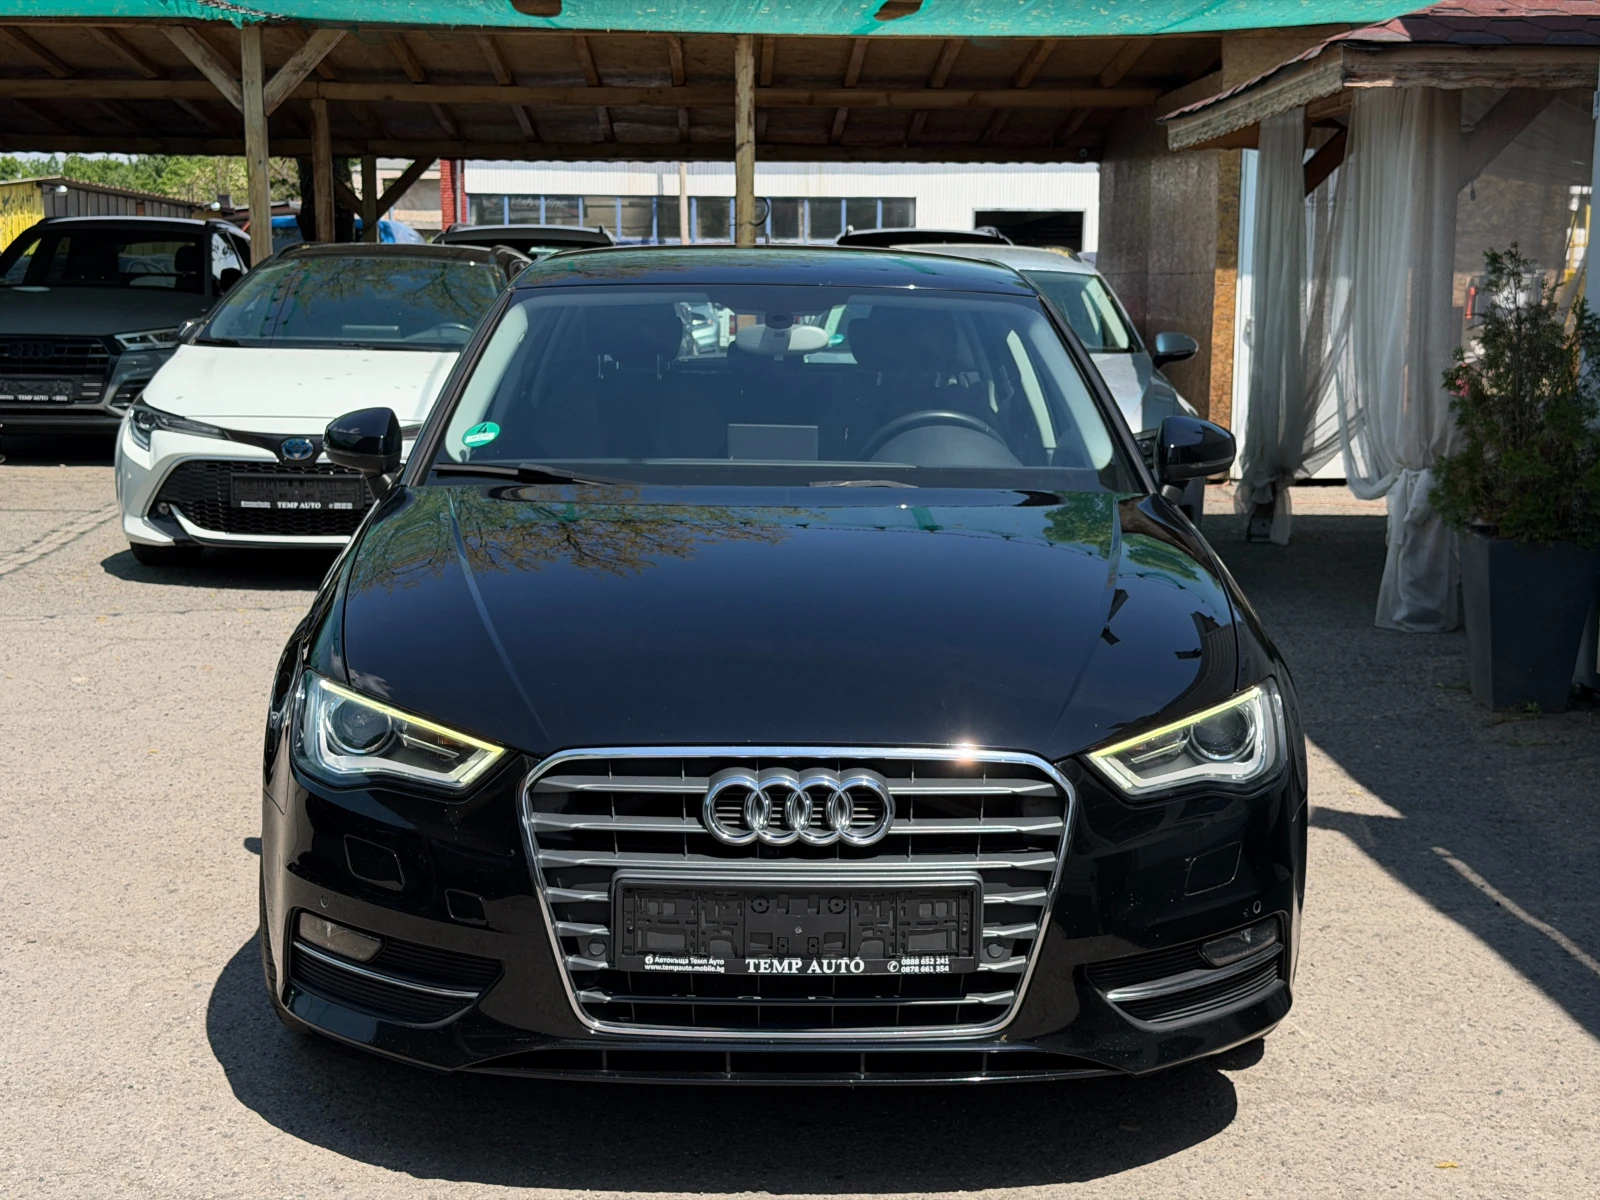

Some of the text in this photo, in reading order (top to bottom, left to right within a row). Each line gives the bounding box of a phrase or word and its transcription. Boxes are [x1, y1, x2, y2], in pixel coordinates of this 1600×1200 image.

[510, 197, 568, 209] Valvline
[277, 501, 299, 509] TEMP
[654, 956, 725, 966] Автокъща Темп Ауто
[745, 958, 865, 974] TEMP AUTO
[900, 957, 950, 966] 0888 652 241
[644, 964, 725, 974] www.tempauto.mobile.bg
[900, 965, 920, 973] 0878
